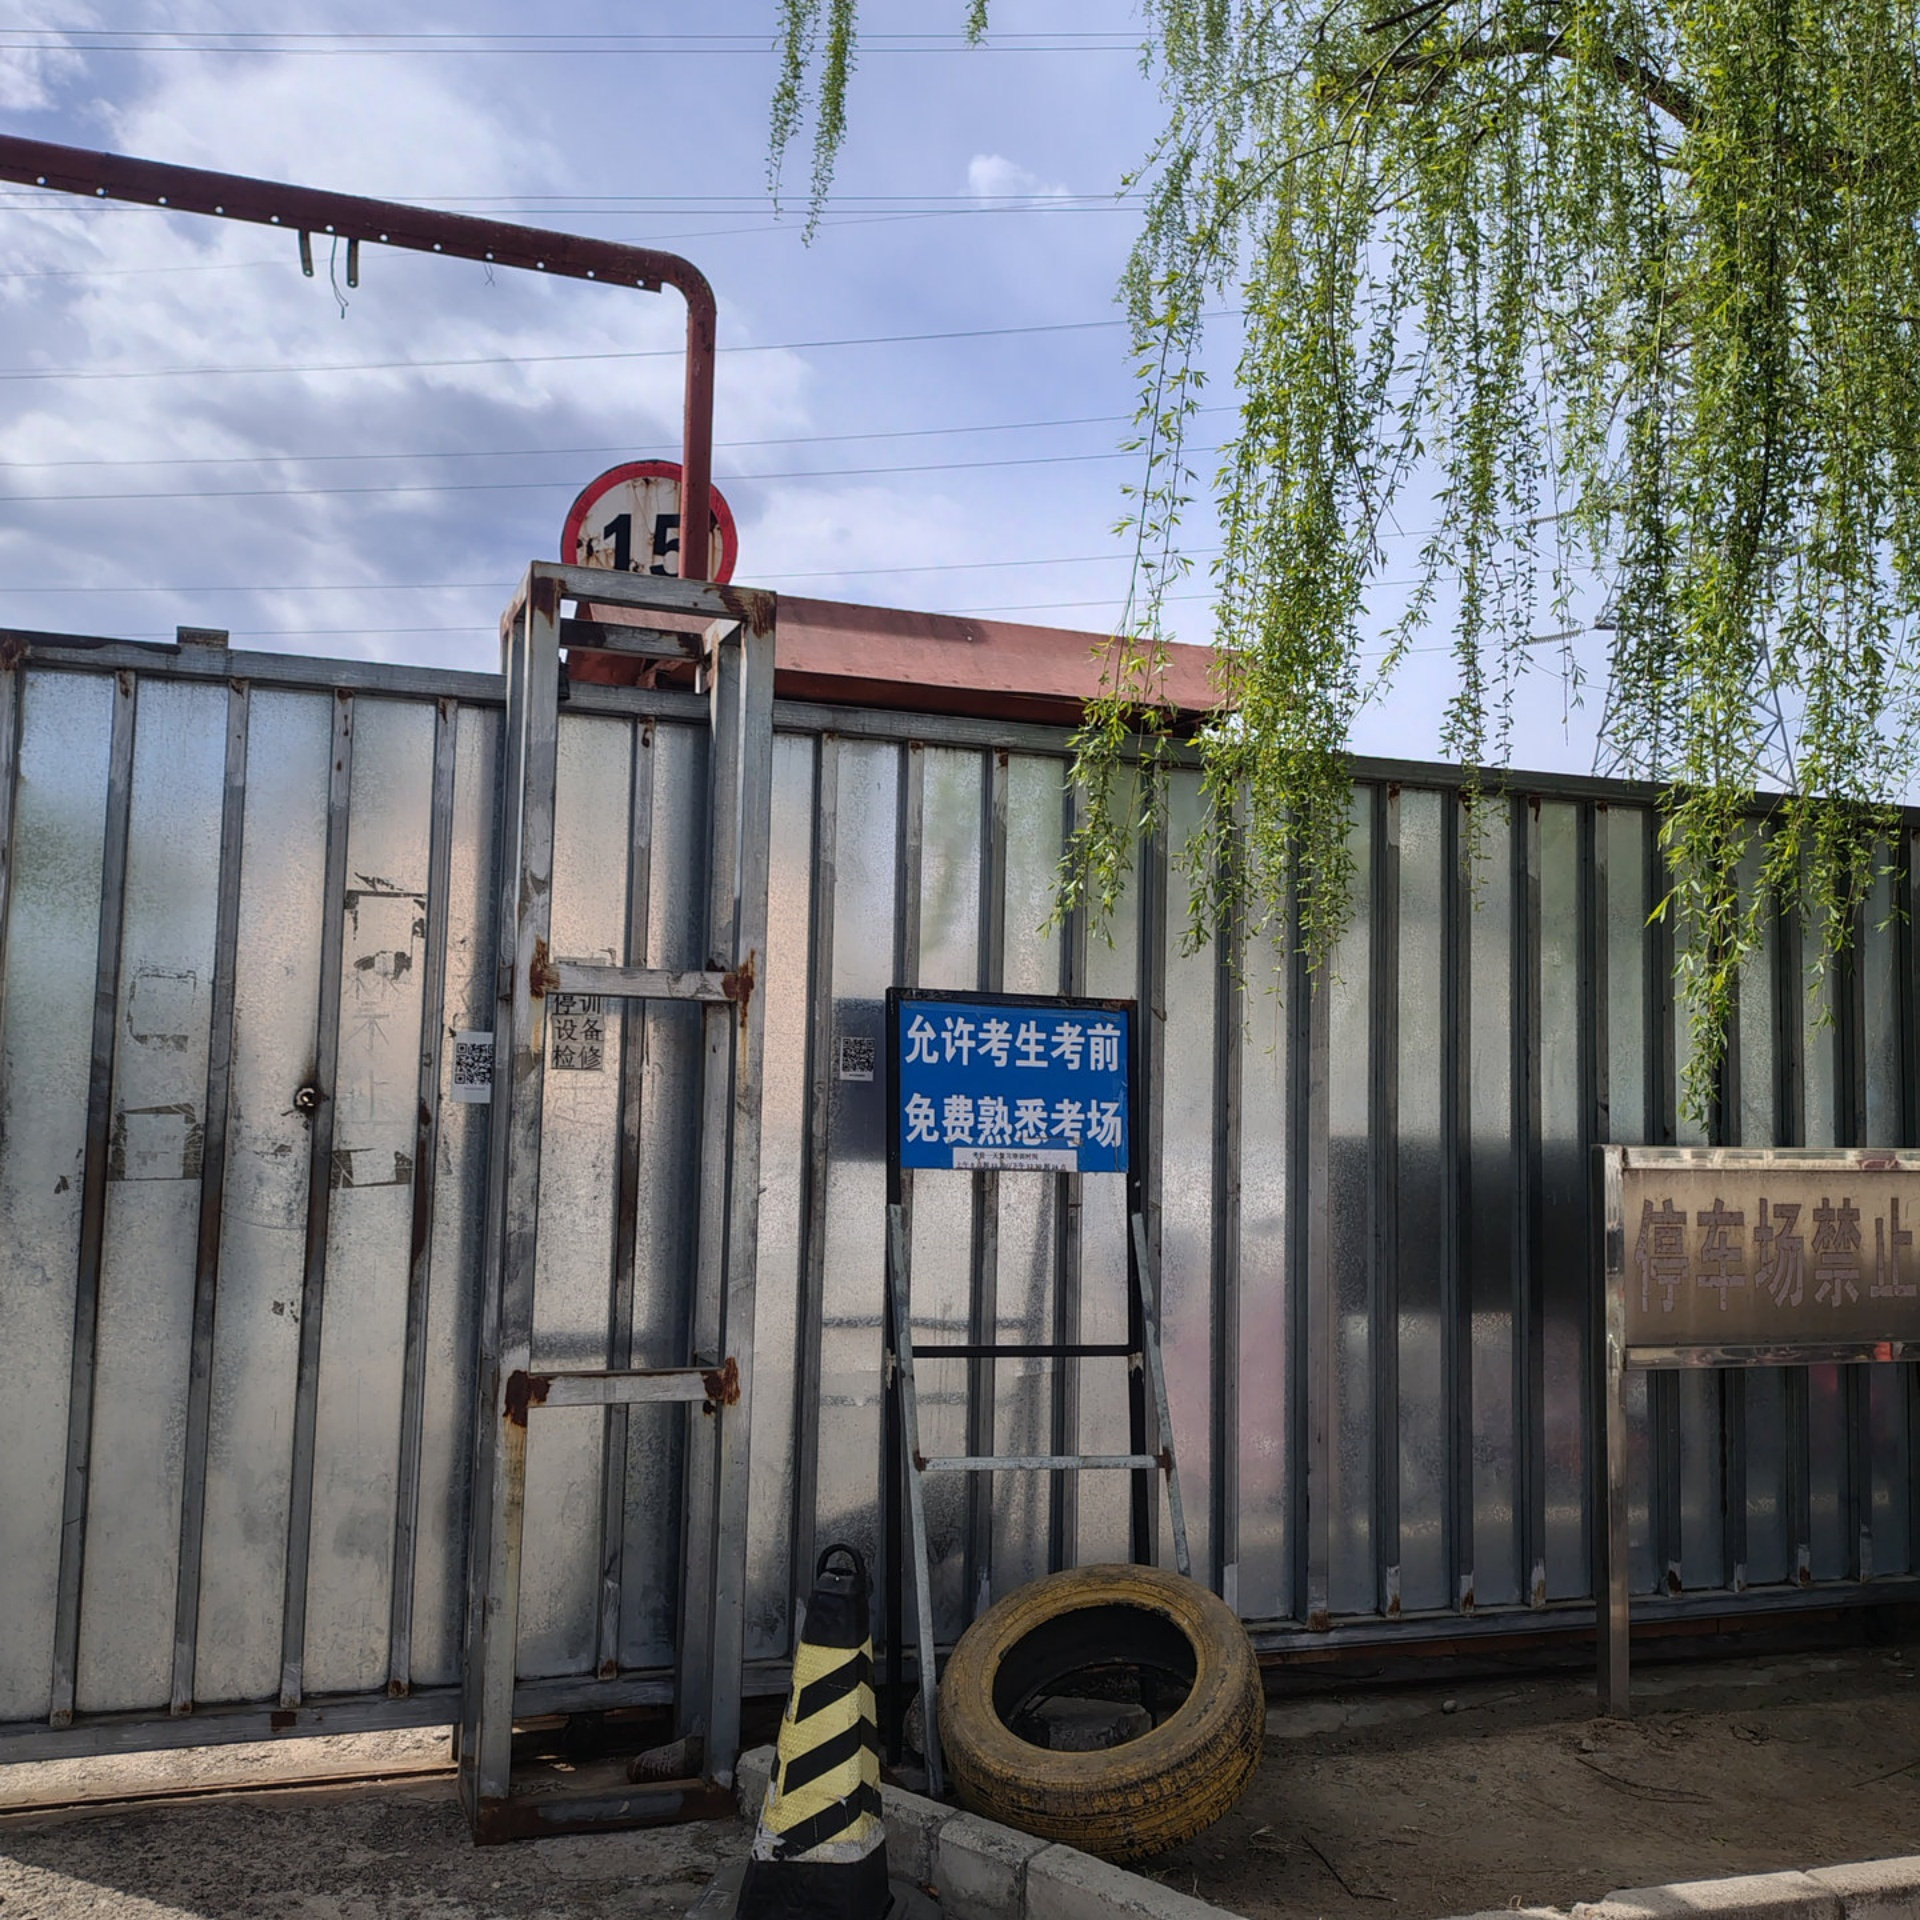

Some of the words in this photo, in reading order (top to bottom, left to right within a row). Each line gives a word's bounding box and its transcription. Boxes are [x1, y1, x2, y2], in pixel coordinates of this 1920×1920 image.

[552, 1018, 603, 1041] 设备
[552, 1045, 602, 1069] 检修
[905, 1014, 1121, 1072] 允许考生考前
[904, 1092, 1122, 1148] 免费熟悉考场
[1635, 1197, 1917, 1313] 停车场禁止
